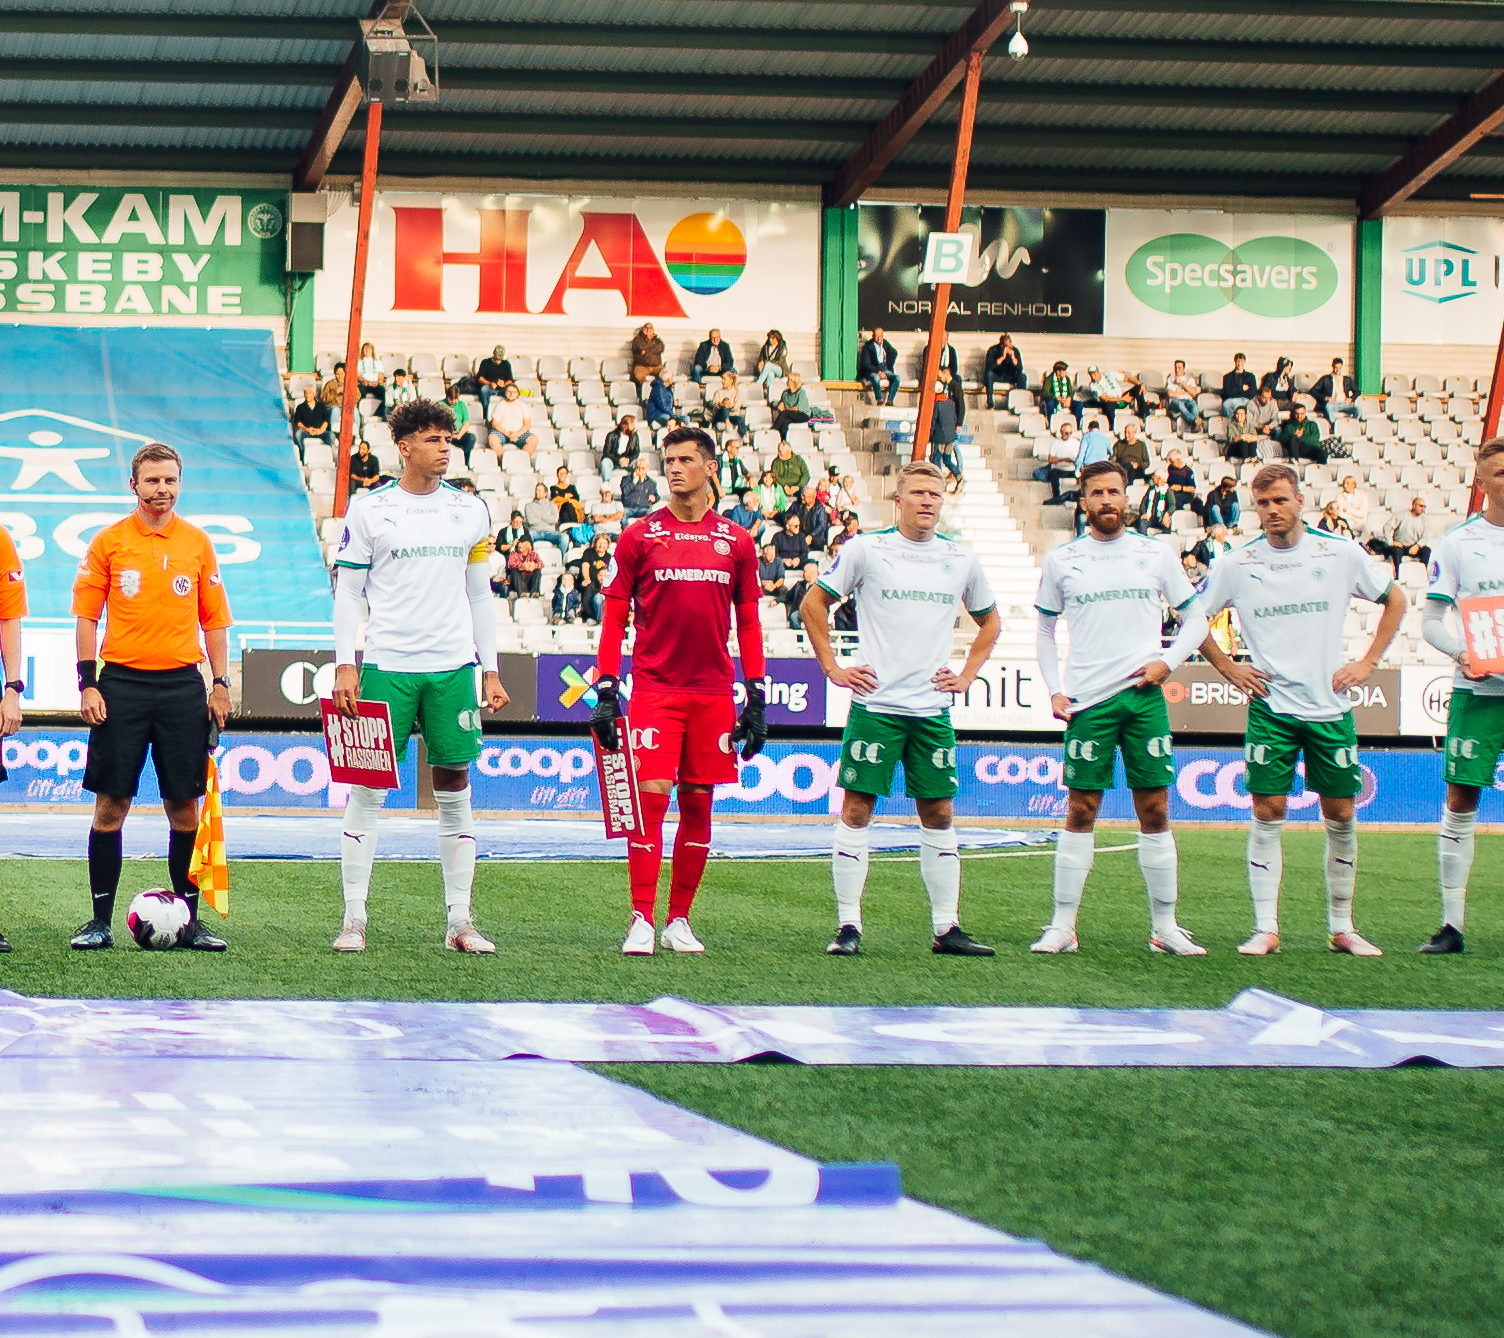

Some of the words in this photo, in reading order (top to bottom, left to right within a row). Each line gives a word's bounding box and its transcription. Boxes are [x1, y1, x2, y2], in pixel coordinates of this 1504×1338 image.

[932, 238, 965, 274] B
[1145, 255, 1318, 292] Specsavers
[1405, 257, 1478, 287] UPL
[888, 300, 972, 315] NORAL
[977, 302, 1073, 317] RENHOLD
[390, 545, 465, 561] KAMERATER
[654, 567, 731, 585] KAMERATER
[881, 587, 955, 605] KAMERATER
[1075, 588, 1152, 606] KAMERATER
[1253, 600, 1330, 619] KAMERATER
[344, 745, 393, 772] RASISMEN
[476, 747, 595, 783] coop
